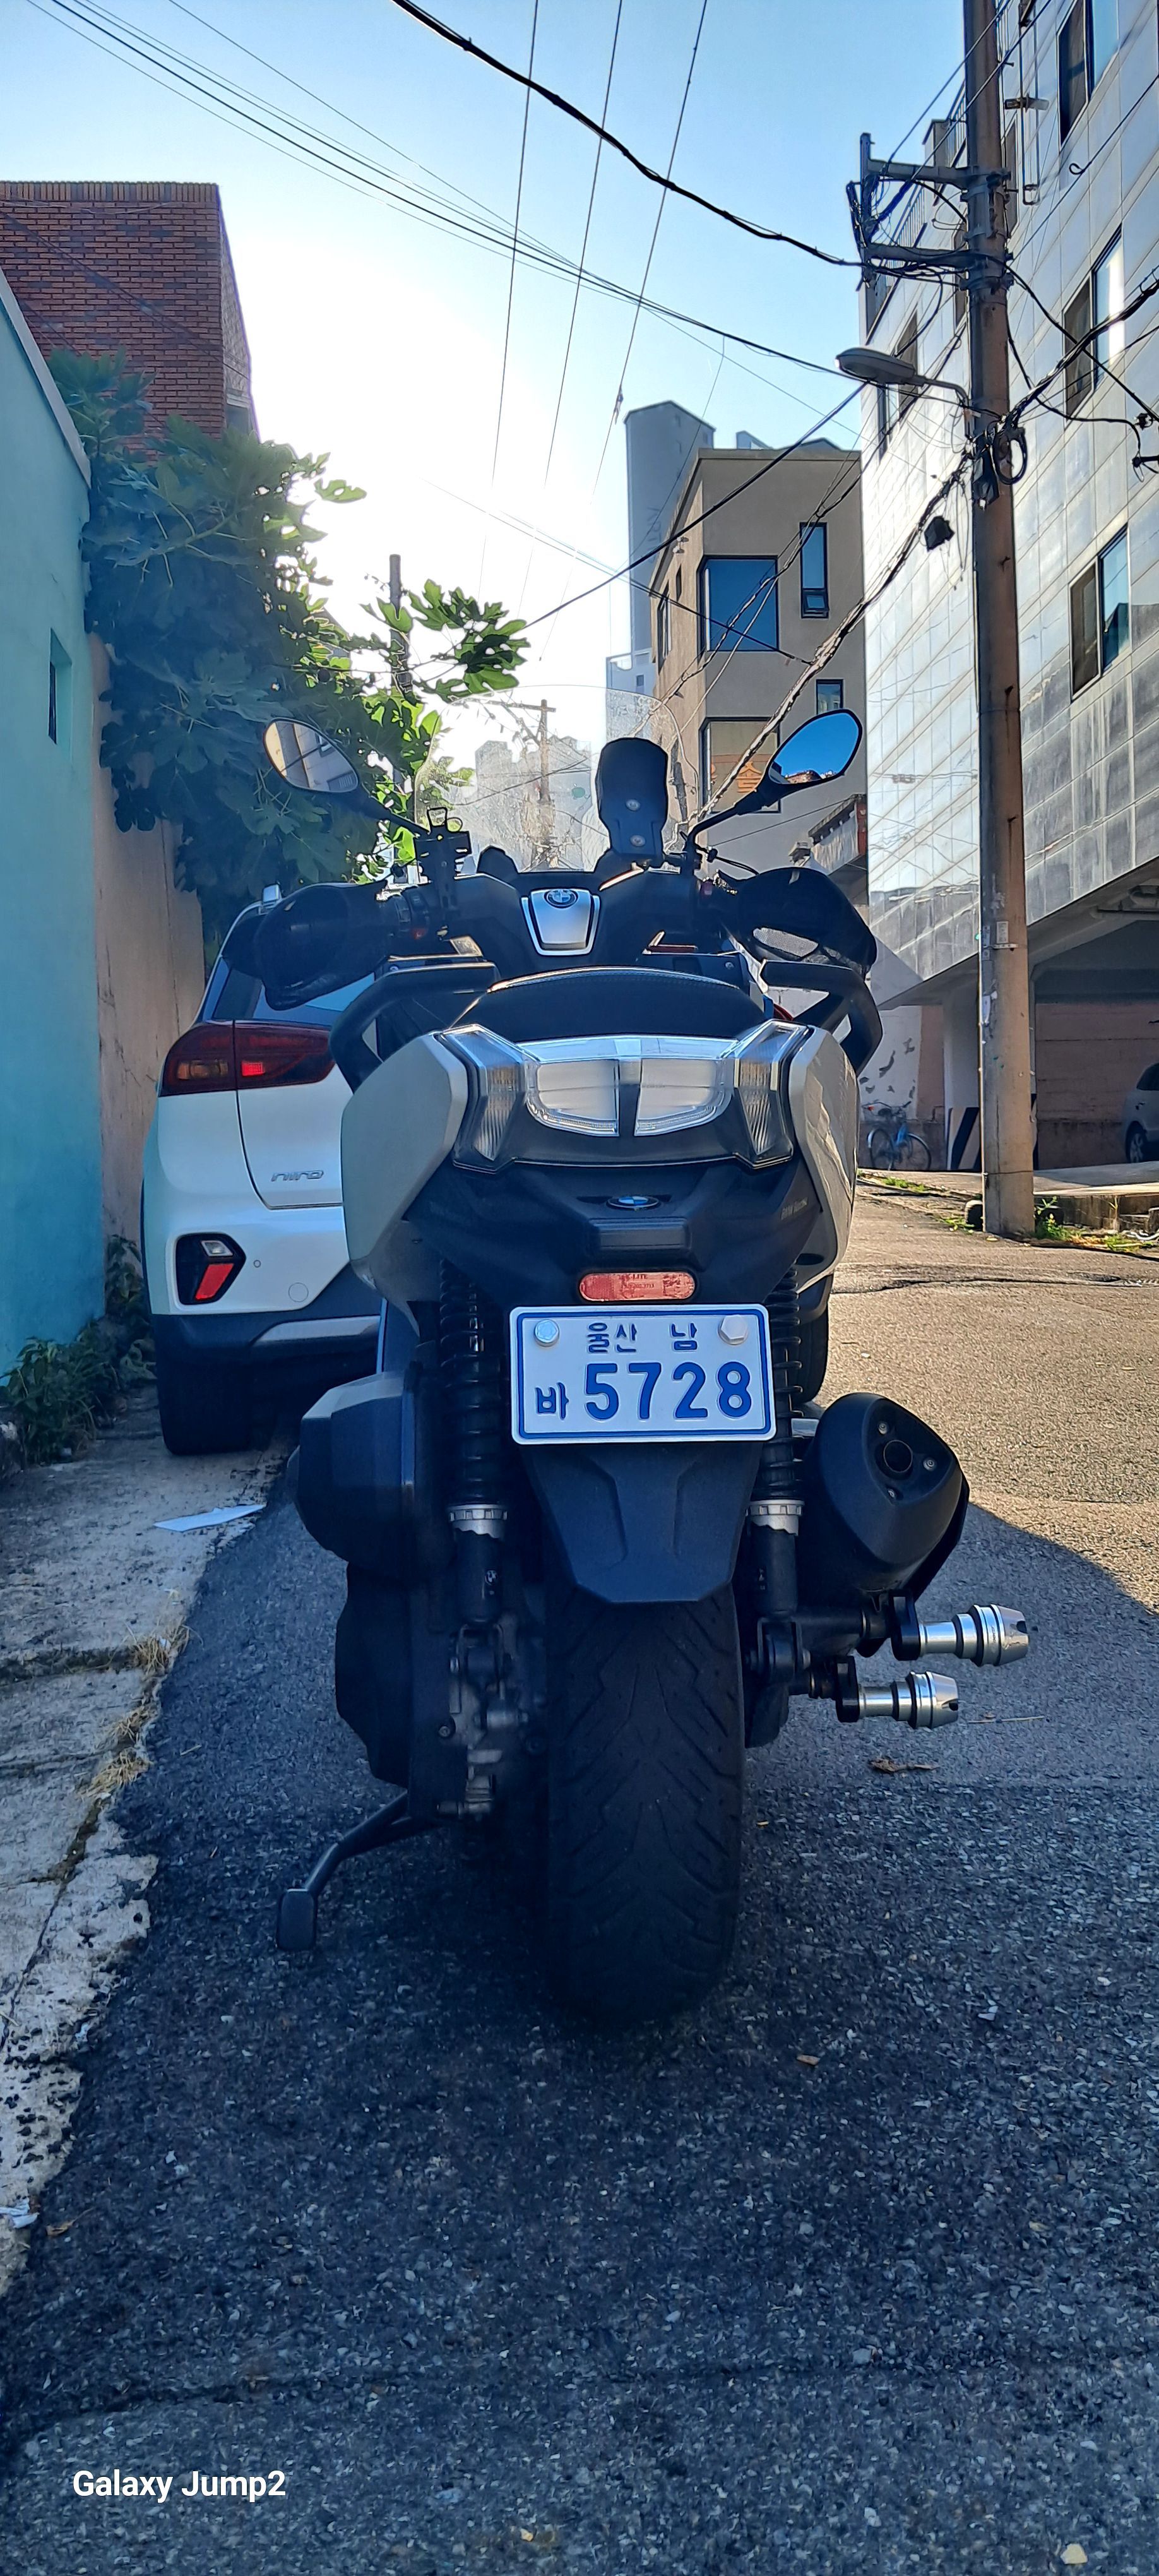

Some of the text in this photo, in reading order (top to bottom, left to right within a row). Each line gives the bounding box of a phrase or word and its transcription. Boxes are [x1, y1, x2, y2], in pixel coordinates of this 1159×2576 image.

[588, 1322, 698, 1353] 울산 남
[535, 1361, 752, 1421] 바 5728
